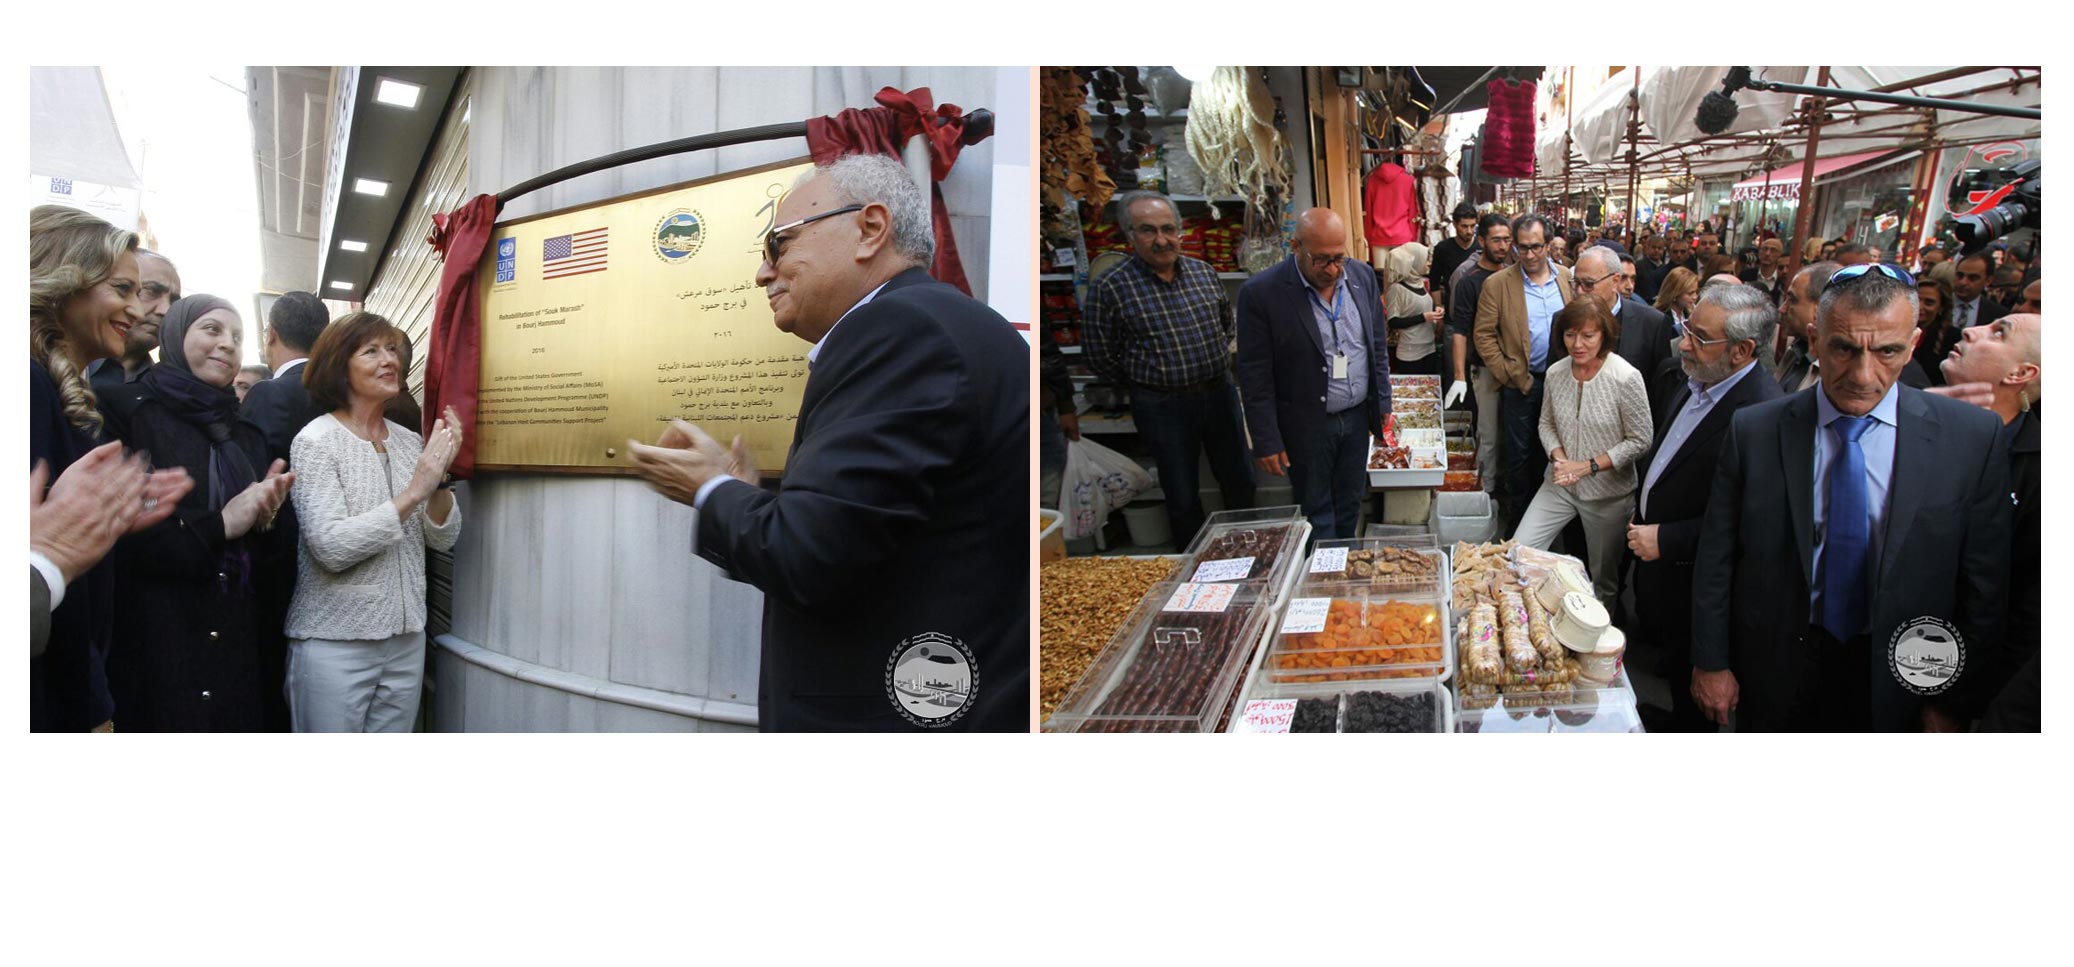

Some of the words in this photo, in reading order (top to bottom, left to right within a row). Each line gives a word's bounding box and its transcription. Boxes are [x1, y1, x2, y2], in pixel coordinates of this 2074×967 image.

[498, 260, 514, 270] UN
[498, 271, 513, 282] DP
[700, 303, 720, 312] حمود
[723, 301, 738, 311] برج
[499, 311, 534, 321] Rehabilitation
[535, 309, 541, 317] of
[522, 321, 537, 329] Bourj
[537, 318, 566, 328] Hammoud
[705, 359, 729, 369] الولايات
[731, 358, 753, 368] حكومة
[767, 355, 789, 363] مقدمة
[682, 360, 703, 370] المتحدة
[712, 373, 727, 382] وزارة
[730, 371, 754, 382] المشروع
[716, 386, 738, 394] المتحدة
[588, 393, 609, 401] (UNDP)
[680, 402, 697, 410] حمود
[730, 401, 740, 410] مع
[740, 413, 755, 422] دعم
